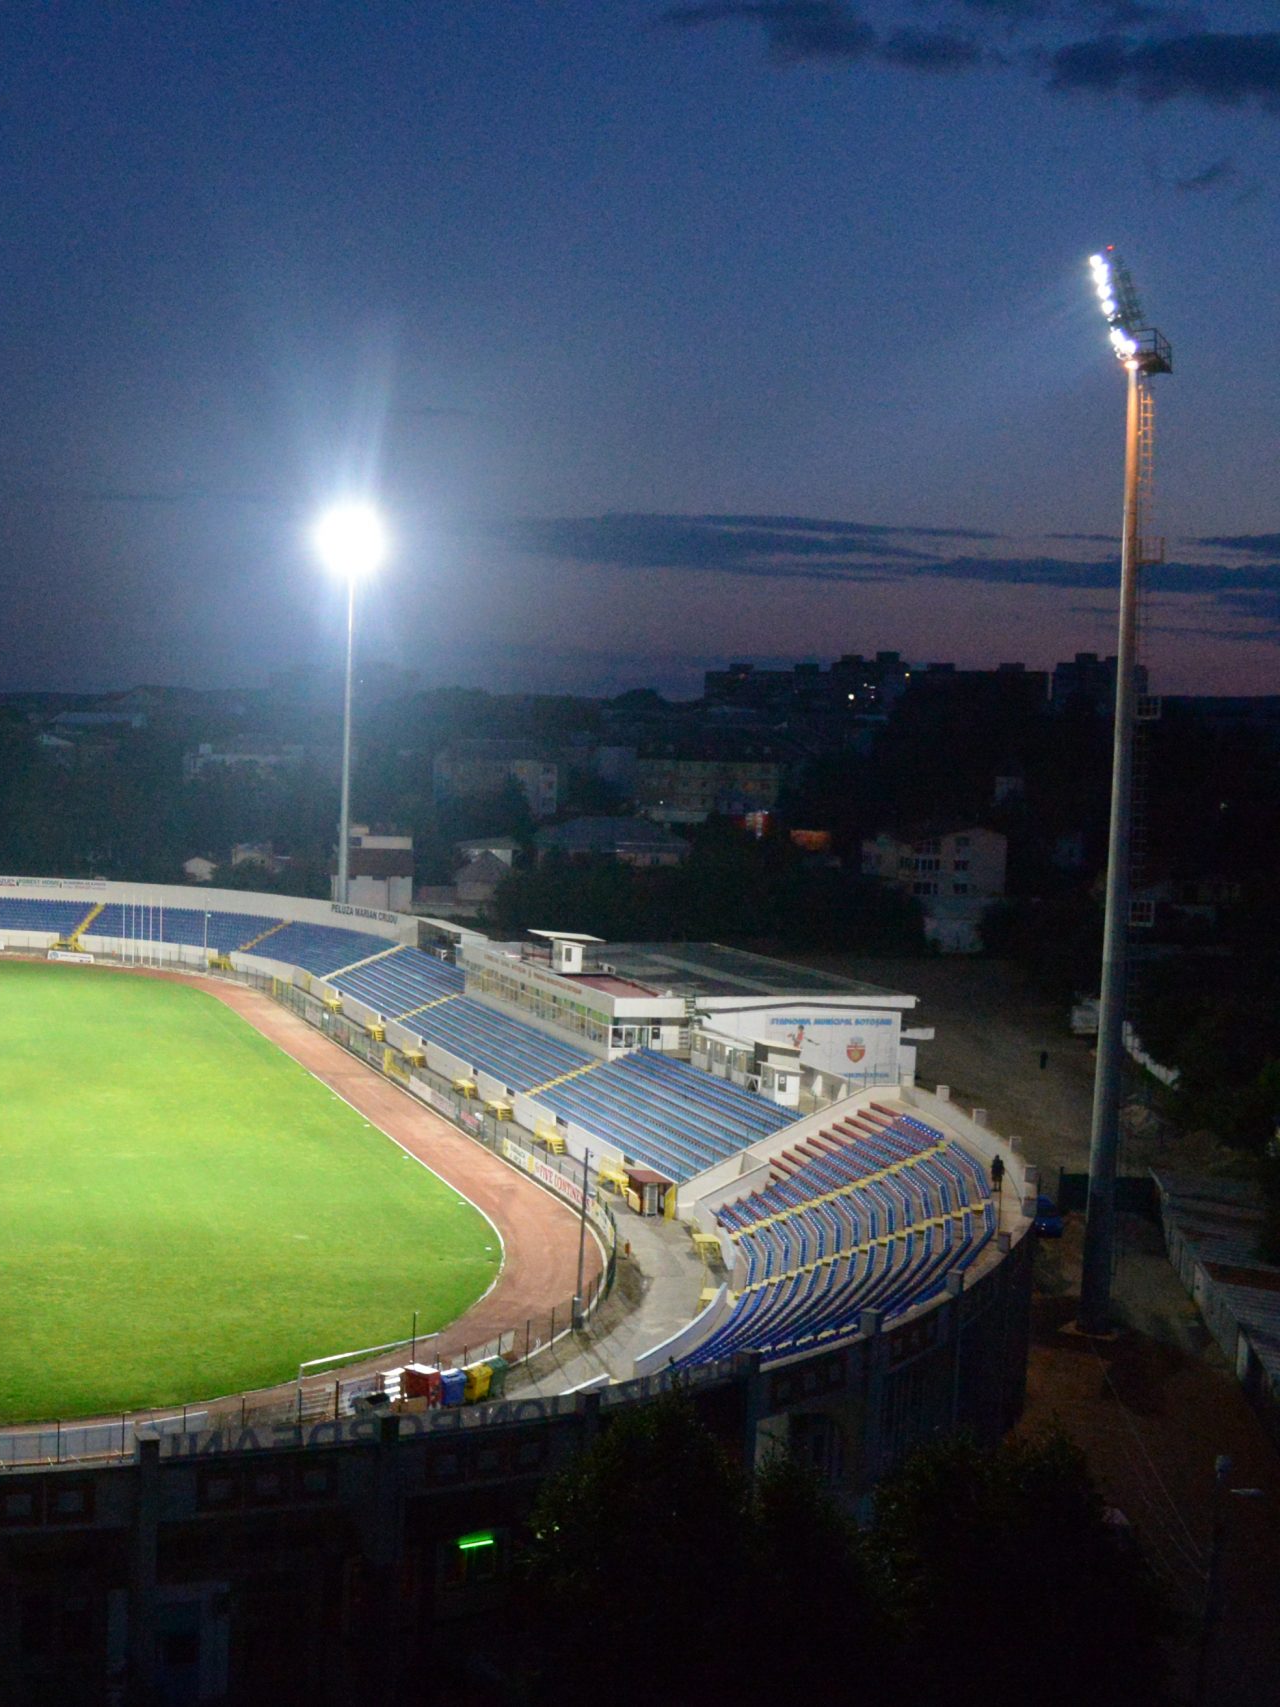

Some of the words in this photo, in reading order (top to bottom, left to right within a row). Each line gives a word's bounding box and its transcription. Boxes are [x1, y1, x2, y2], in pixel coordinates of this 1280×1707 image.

[331, 904, 353, 916] PELUZA
[354, 907, 378, 921] MARIAN
[814, 1017, 852, 1026] MUNICIPAL
